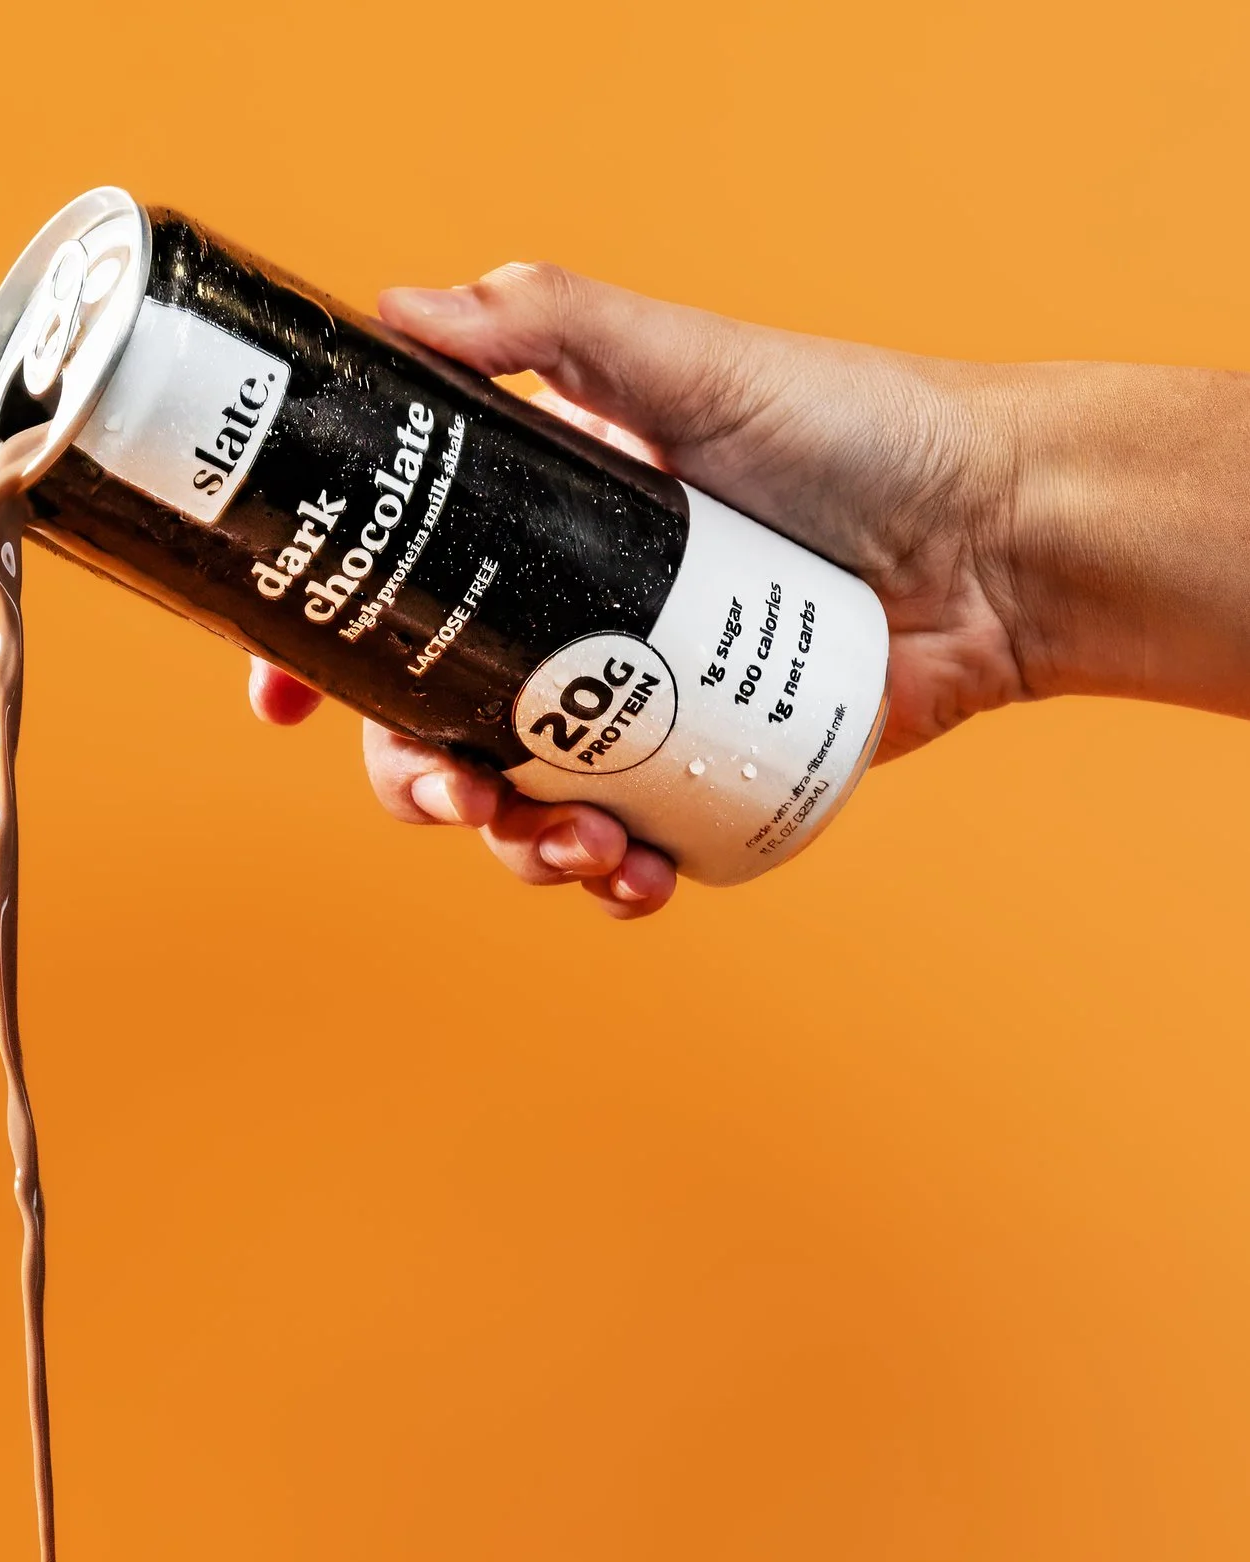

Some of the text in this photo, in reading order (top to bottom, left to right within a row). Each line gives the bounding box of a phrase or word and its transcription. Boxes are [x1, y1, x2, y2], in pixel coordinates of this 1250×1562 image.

[193, 373, 275, 496] slate.
[251, 489, 347, 600] dark
[304, 402, 434, 624] chocolate
[338, 600, 383, 643] high
[376, 529, 430, 607] protein
[407, 556, 500, 678] LACTOSE FREE
[700, 596, 743, 687] 1g sugar
[734, 581, 782, 706] 100 calories
[529, 656, 635, 752] 20G
[577, 672, 661, 766] PROTEIN
[768, 599, 816, 724] 1g net carbs
[745, 824, 772, 849] made
[771, 801, 792, 824] with
[832, 703, 847, 731] milk
